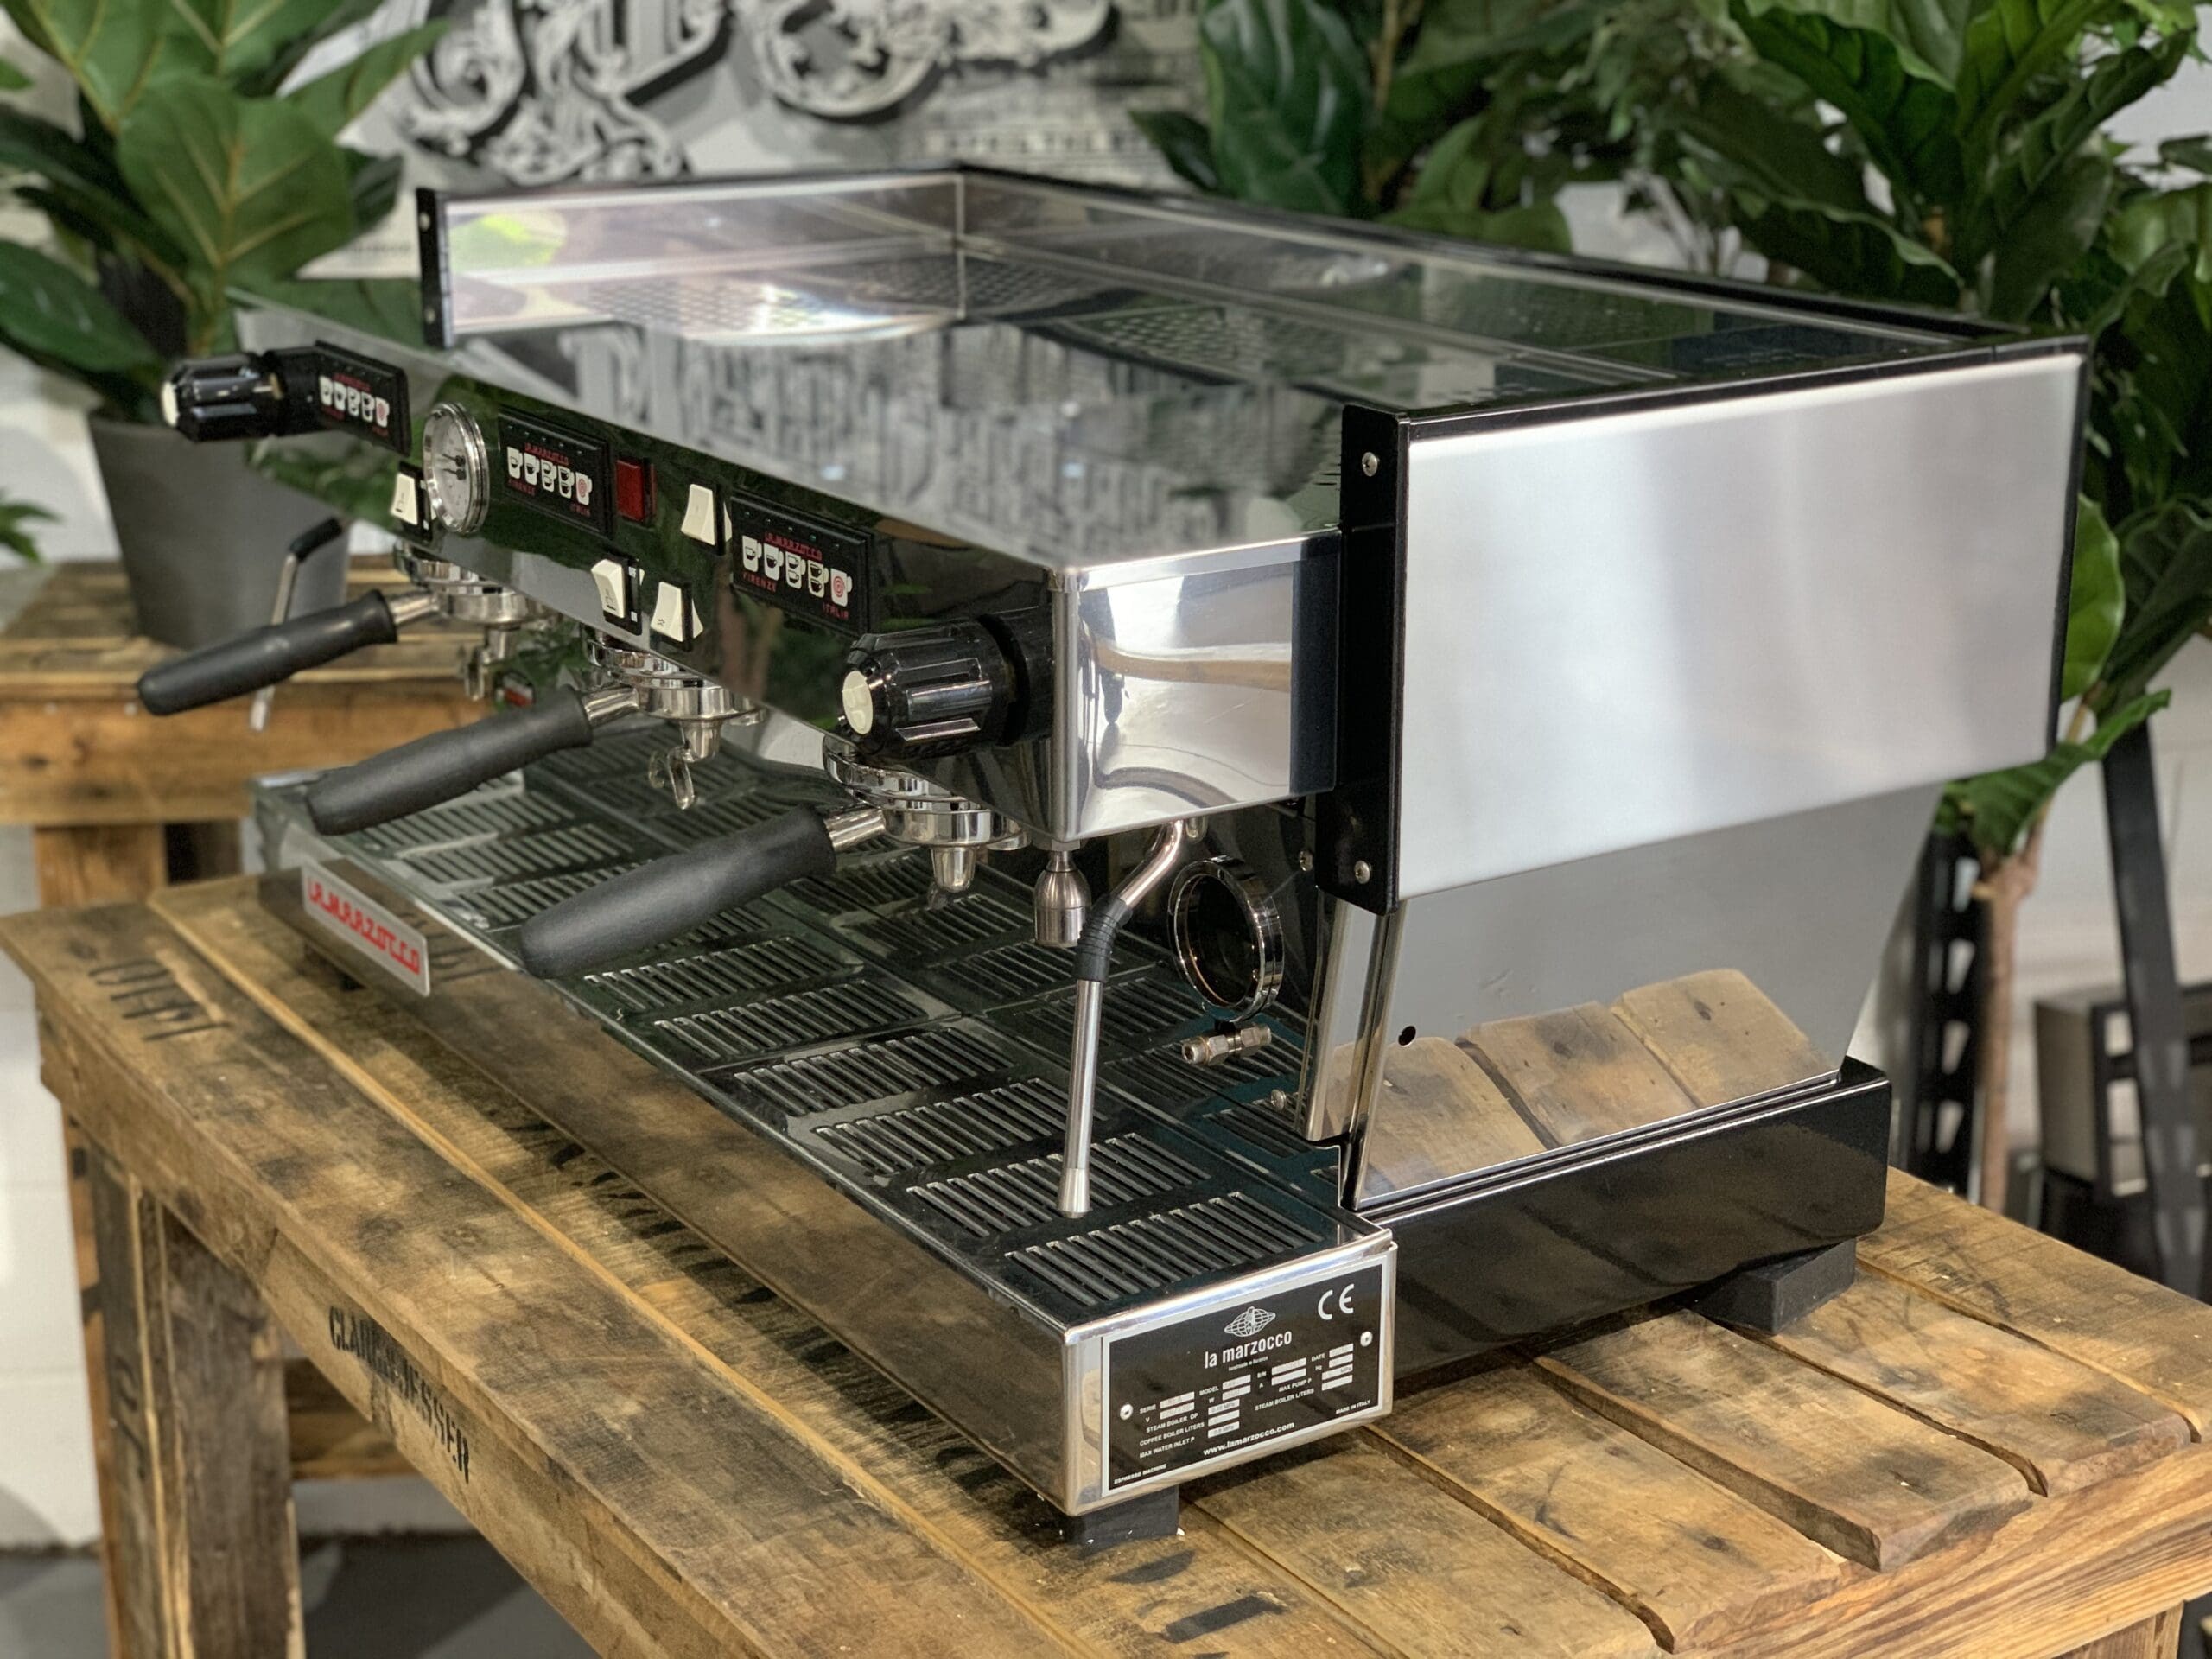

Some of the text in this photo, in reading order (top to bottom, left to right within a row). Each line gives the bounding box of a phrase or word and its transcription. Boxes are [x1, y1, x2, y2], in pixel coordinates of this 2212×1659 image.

[1205, 1331, 1293, 1370] la marzocco
[1311, 1353, 1325, 1362] DATE
[1199, 1385, 1219, 1396] MODEL
[1255, 1388, 1314, 1411] STEAM BOILER LITERS
[1139, 1422, 1205, 1446] COFFEE BOILER LITERS
[1146, 1422, 1166, 1433] STEAM
[1166, 1416, 1188, 1427] BOILER
[1139, 1450, 1152, 1459] MAX
[1153, 1443, 1173, 1454] WATER
[1173, 1438, 1190, 1448] INLET
[1203, 1422, 1294, 1455] www.lamarzocco.com
